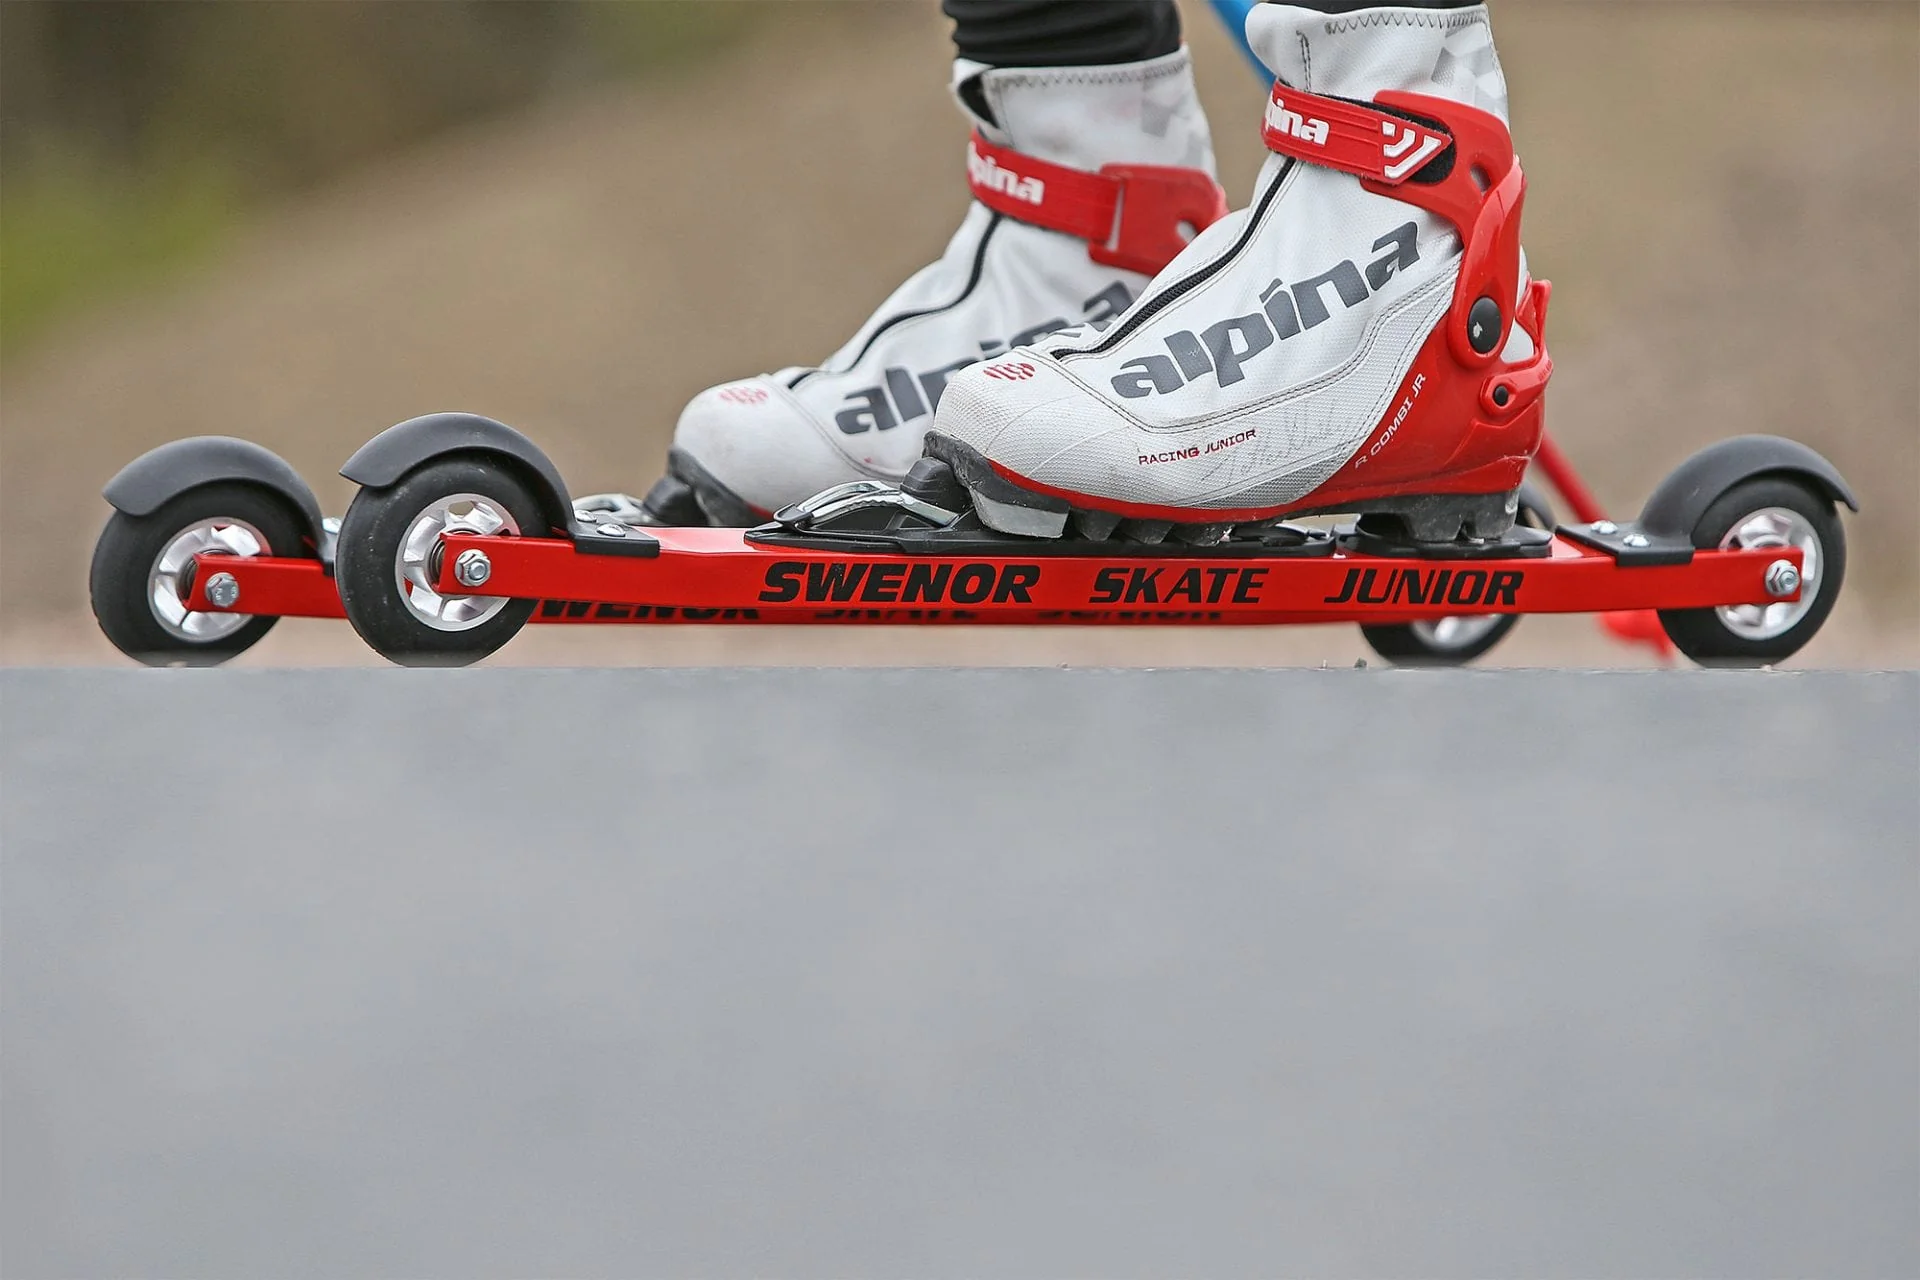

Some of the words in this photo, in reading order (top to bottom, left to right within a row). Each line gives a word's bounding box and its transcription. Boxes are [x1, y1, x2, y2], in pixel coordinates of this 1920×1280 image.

[1110, 221, 1420, 399] alpina
[1138, 446, 1200, 465] RACING
[1204, 429, 1257, 455] JUNIOR
[1354, 454, 1368, 469] R
[1370, 398, 1413, 456] COMBI
[1413, 372, 1427, 398] JR
[758, 561, 1041, 604] SWENOR
[1088, 567, 1269, 604] SKATE
[1323, 568, 1524, 606] JUNIOR
